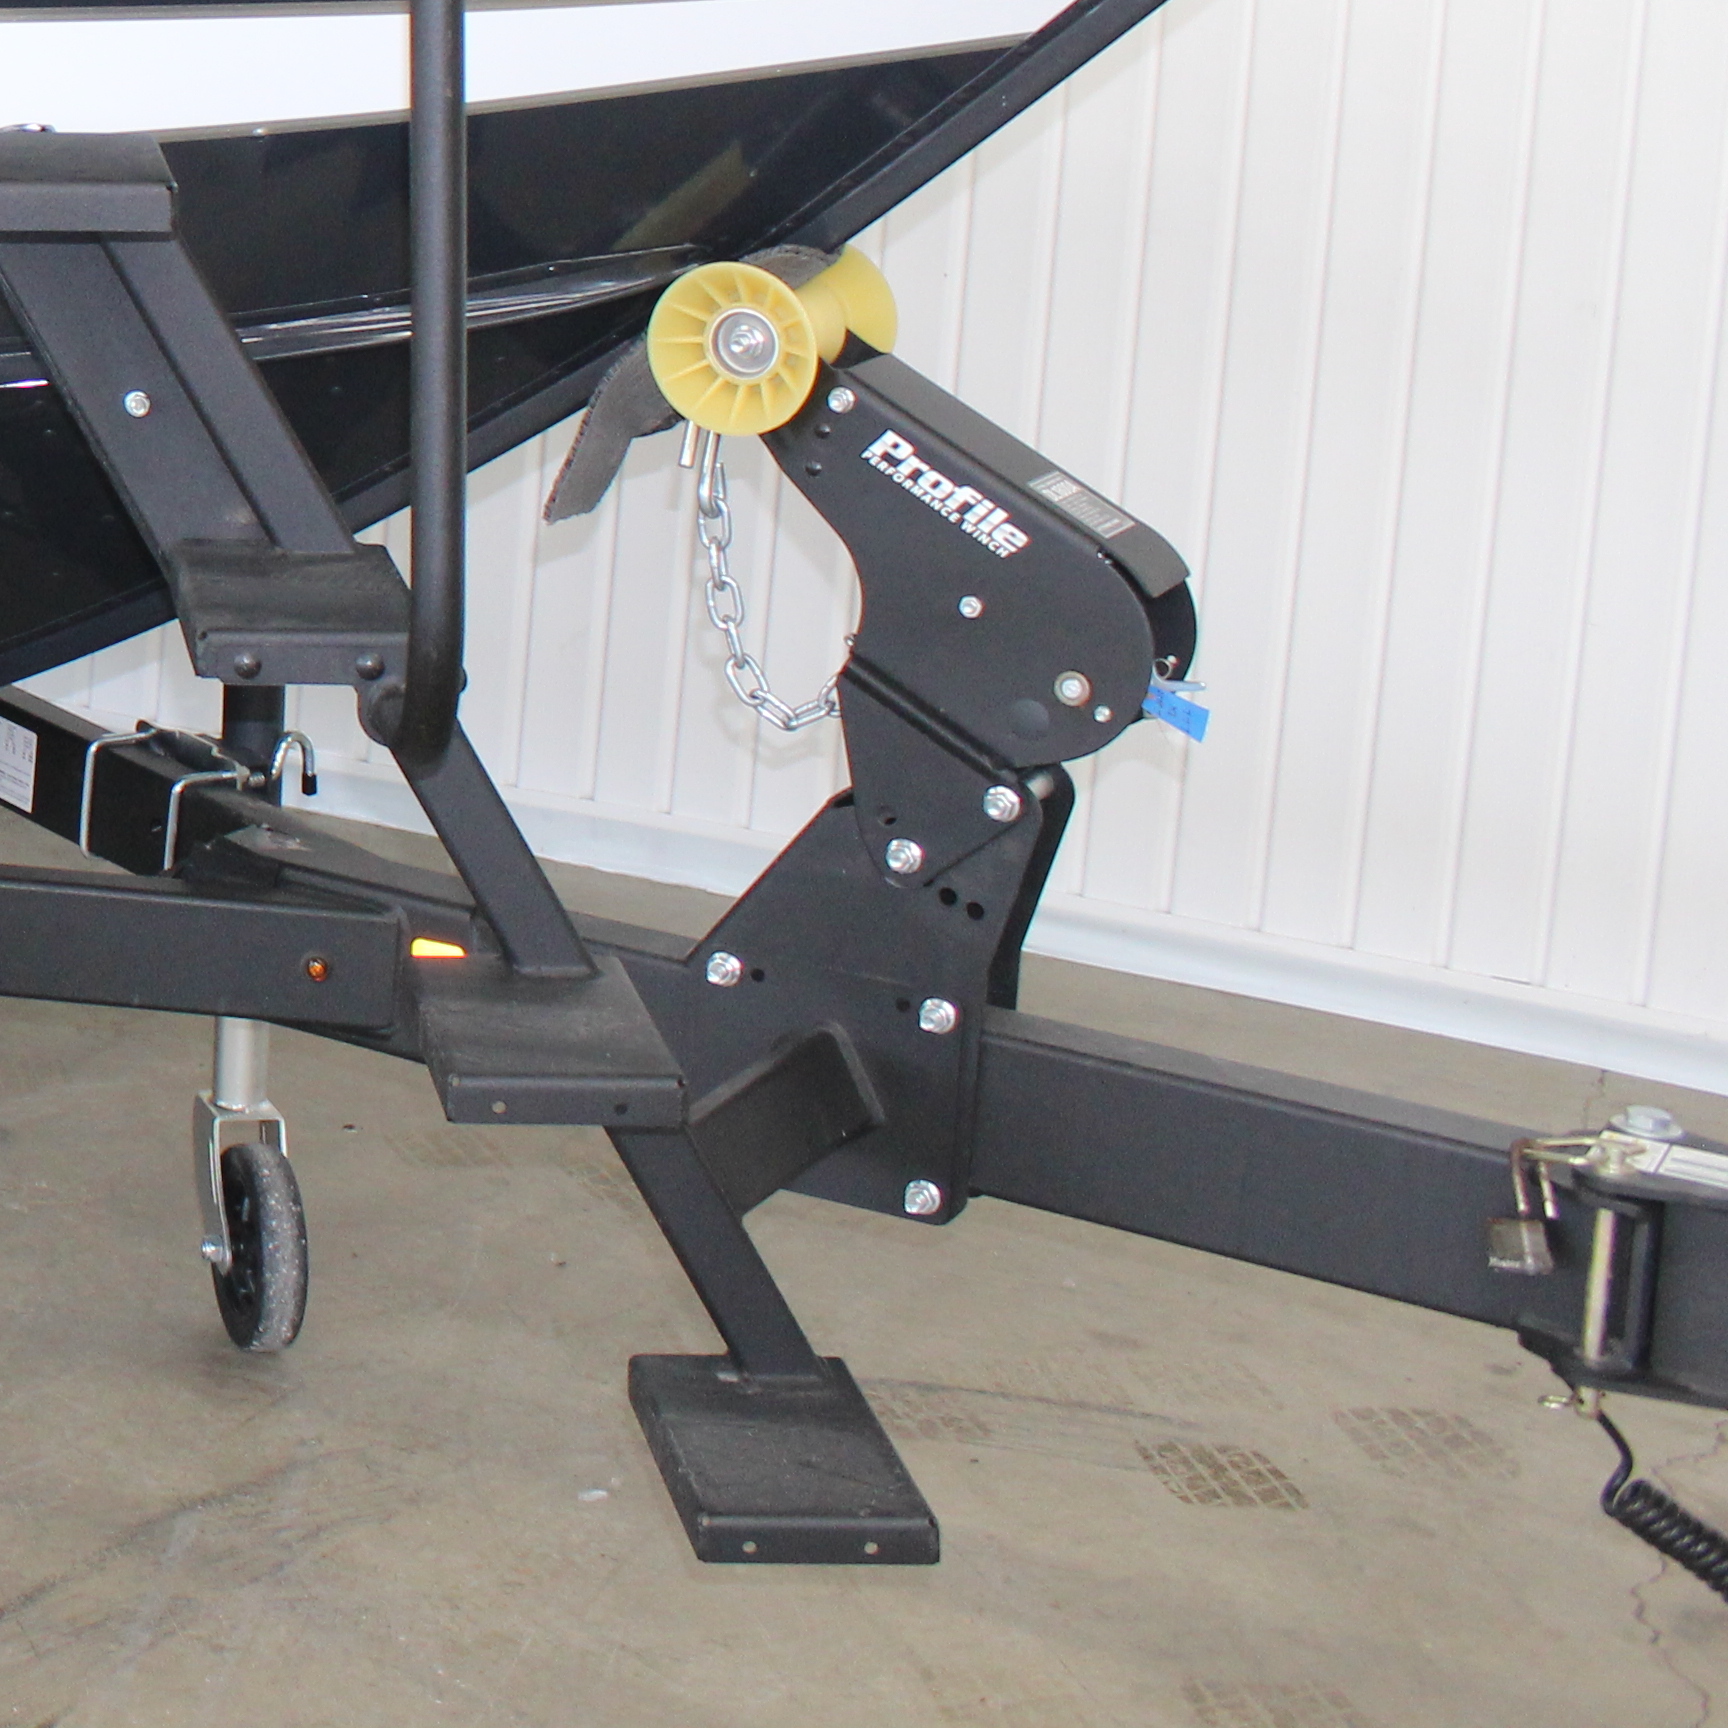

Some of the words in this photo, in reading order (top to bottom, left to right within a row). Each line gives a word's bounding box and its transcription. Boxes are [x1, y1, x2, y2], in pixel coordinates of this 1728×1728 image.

[860, 449, 962, 524] PERFORMANCE
[960, 520, 1011, 559] WINCH
[868, 428, 1031, 554] Profile
